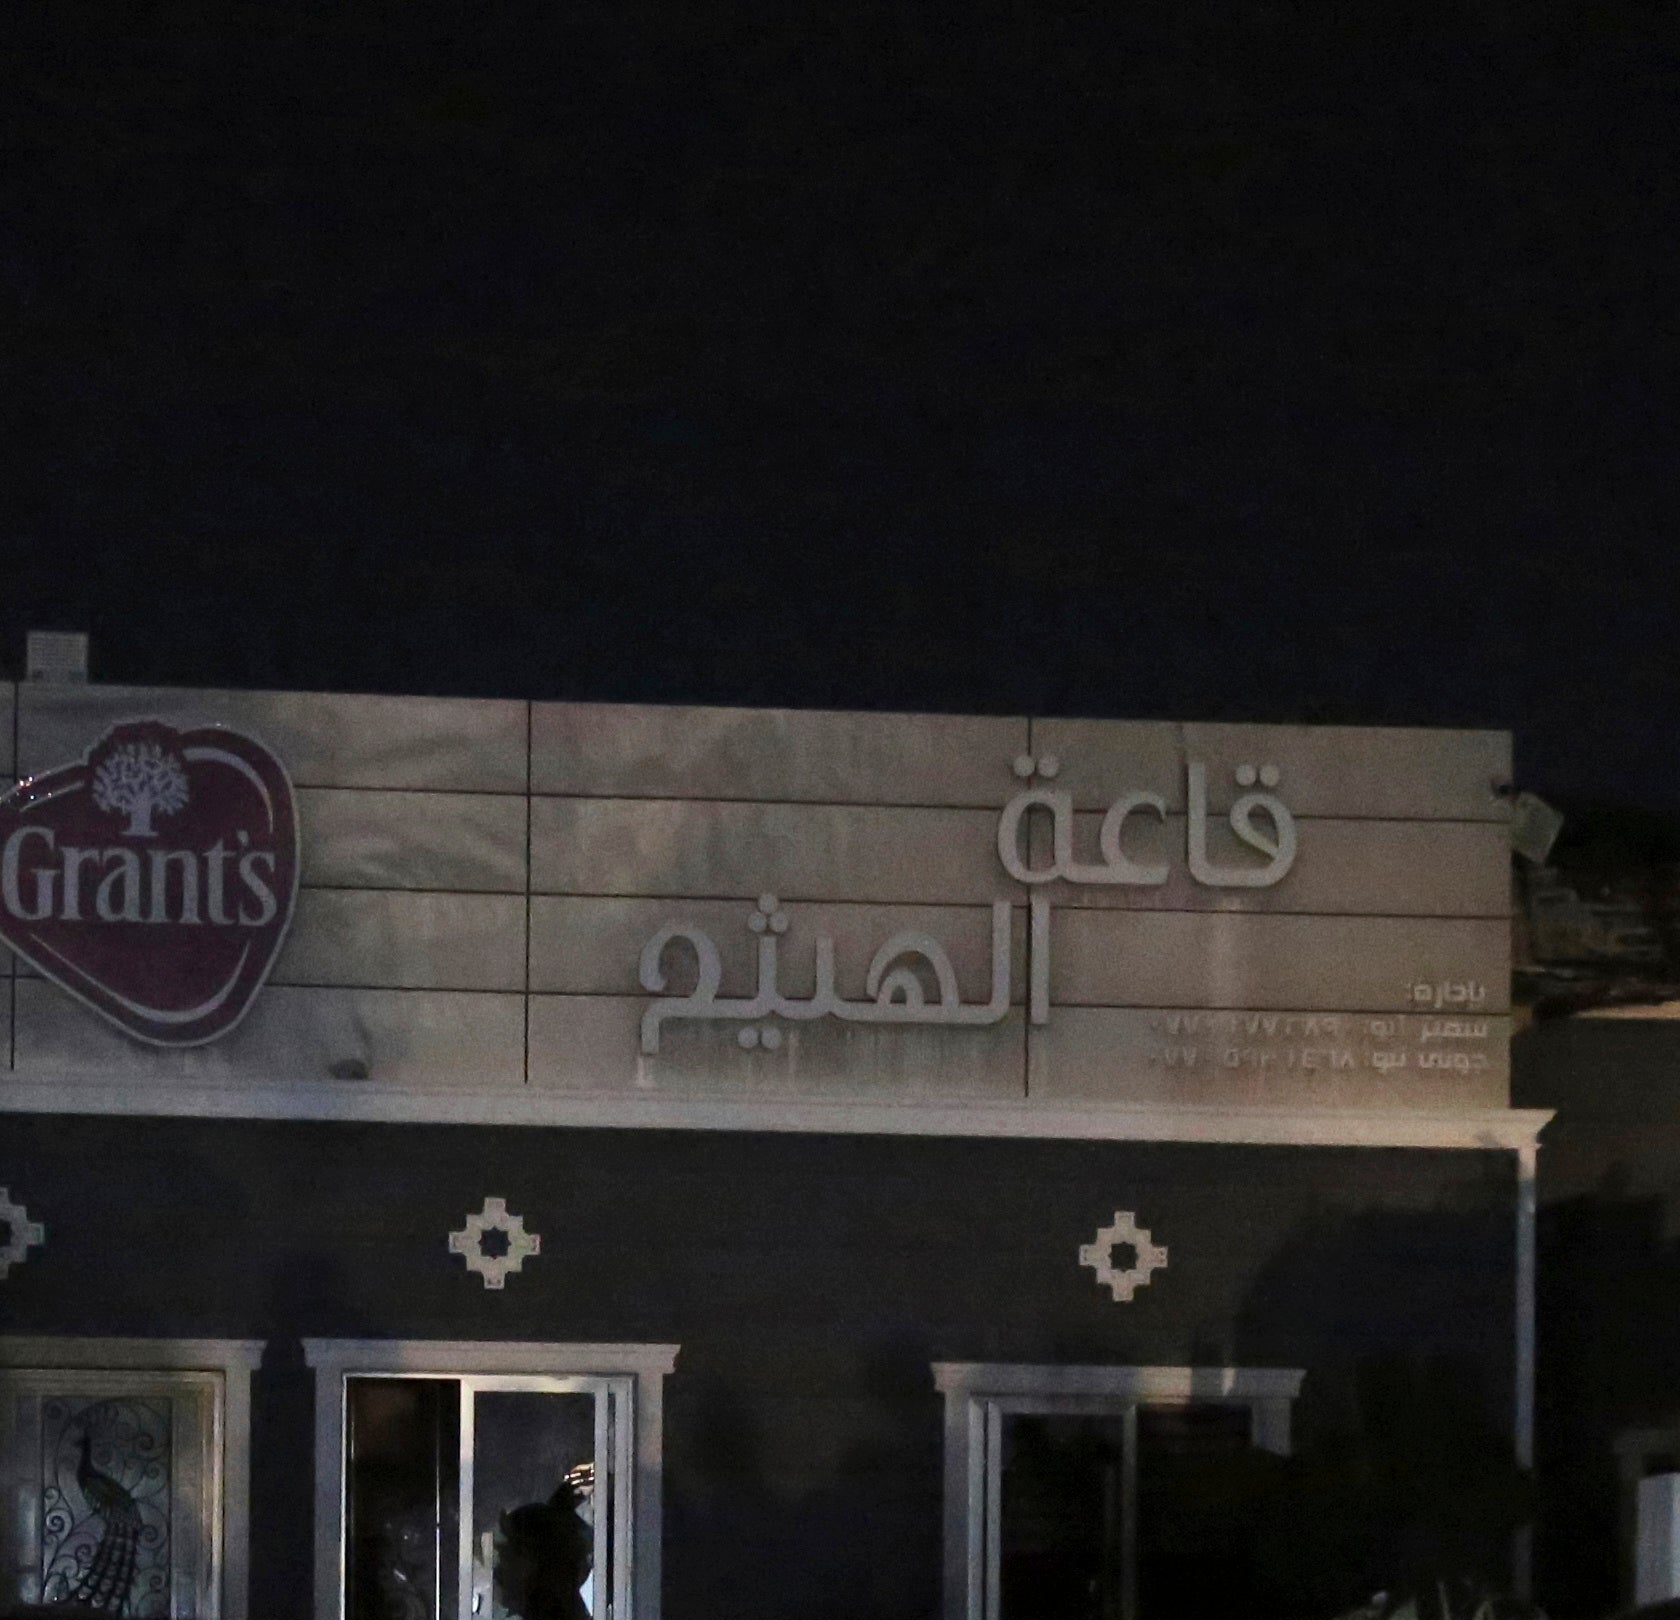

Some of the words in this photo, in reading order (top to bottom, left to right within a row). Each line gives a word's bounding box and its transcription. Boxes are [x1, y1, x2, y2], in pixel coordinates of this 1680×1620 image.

[2, 826, 277, 926] Grant's
[997, 755, 1297, 889] قاعة
[638, 893, 1051, 1054] الهيثم
